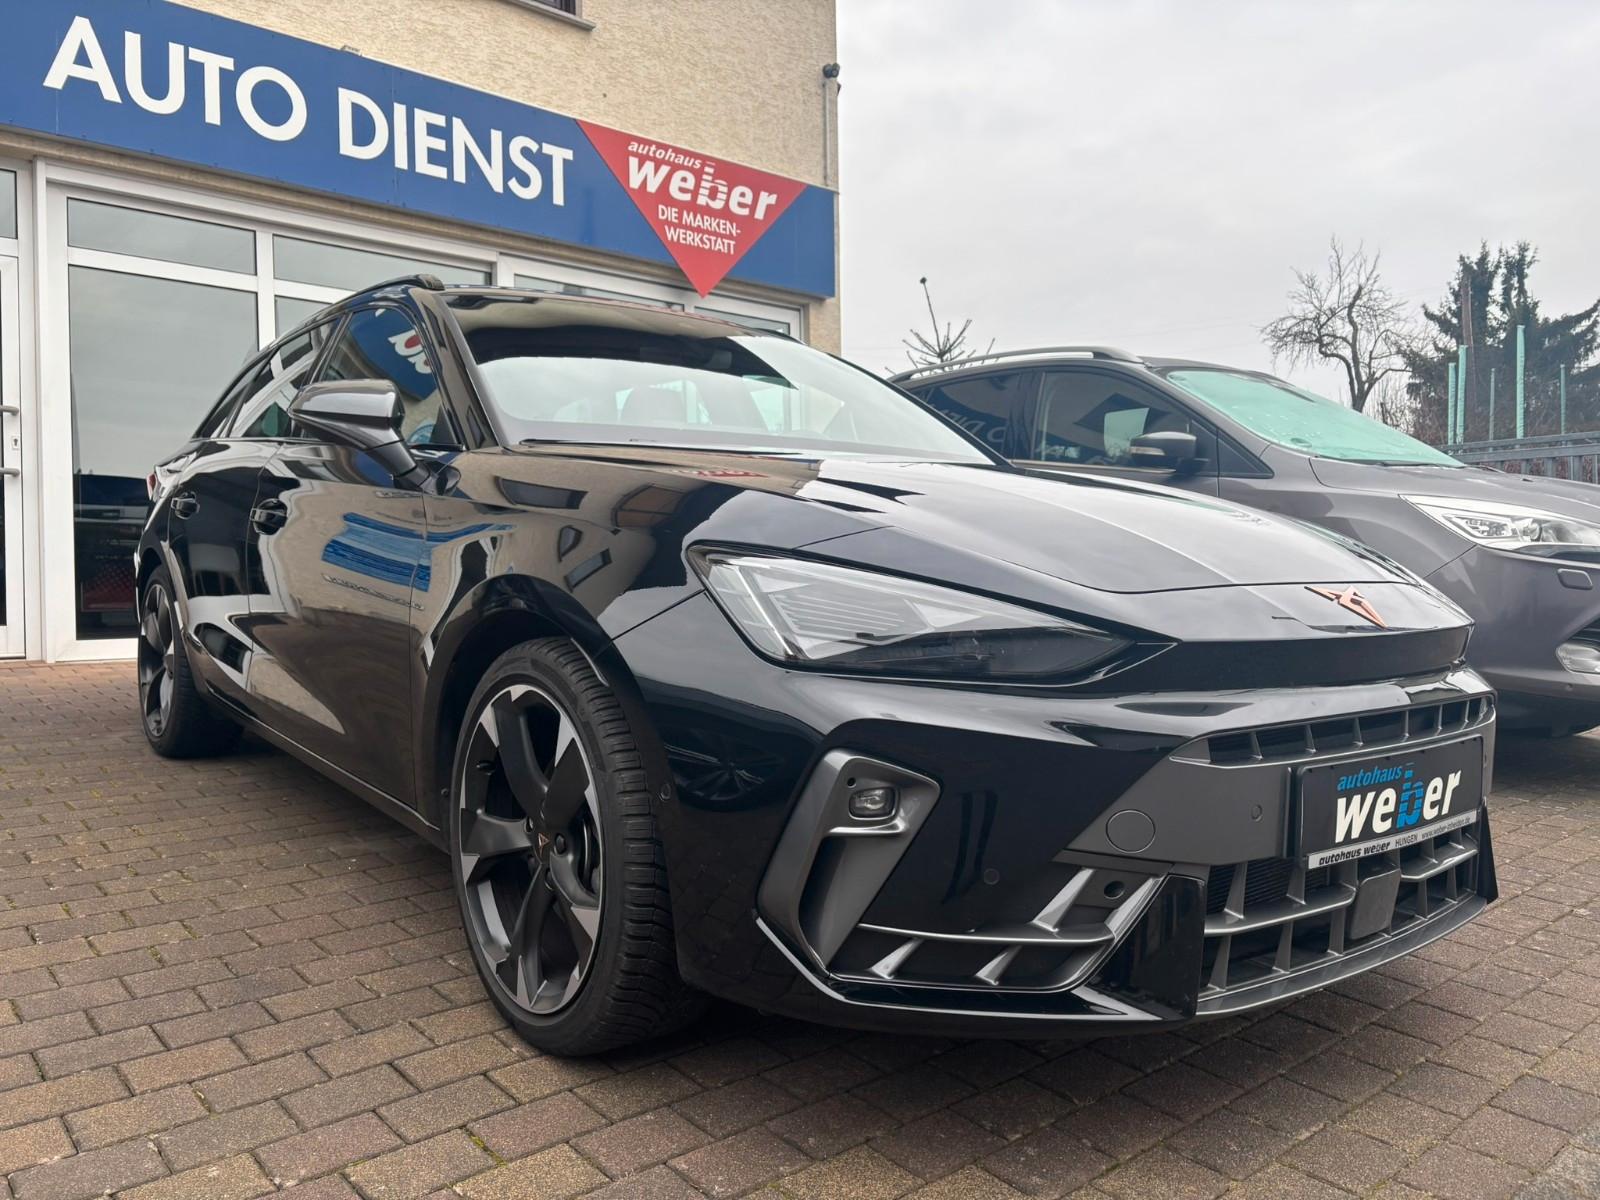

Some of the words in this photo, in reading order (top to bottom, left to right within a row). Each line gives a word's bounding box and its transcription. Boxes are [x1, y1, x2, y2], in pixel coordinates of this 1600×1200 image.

[43, 15, 308, 142] AUTO
[338, 87, 574, 207] DIENST
[627, 141, 703, 170] autohaus
[627, 161, 779, 221] weber
[657, 204, 679, 223] DIE
[682, 210, 741, 237] MARKEN-
[664, 225, 736, 255] WERKSTATT
[1337, 766, 1403, 792] autohaus
[1335, 762, 1462, 843] weber
[1319, 849, 1362, 866] autohaus
